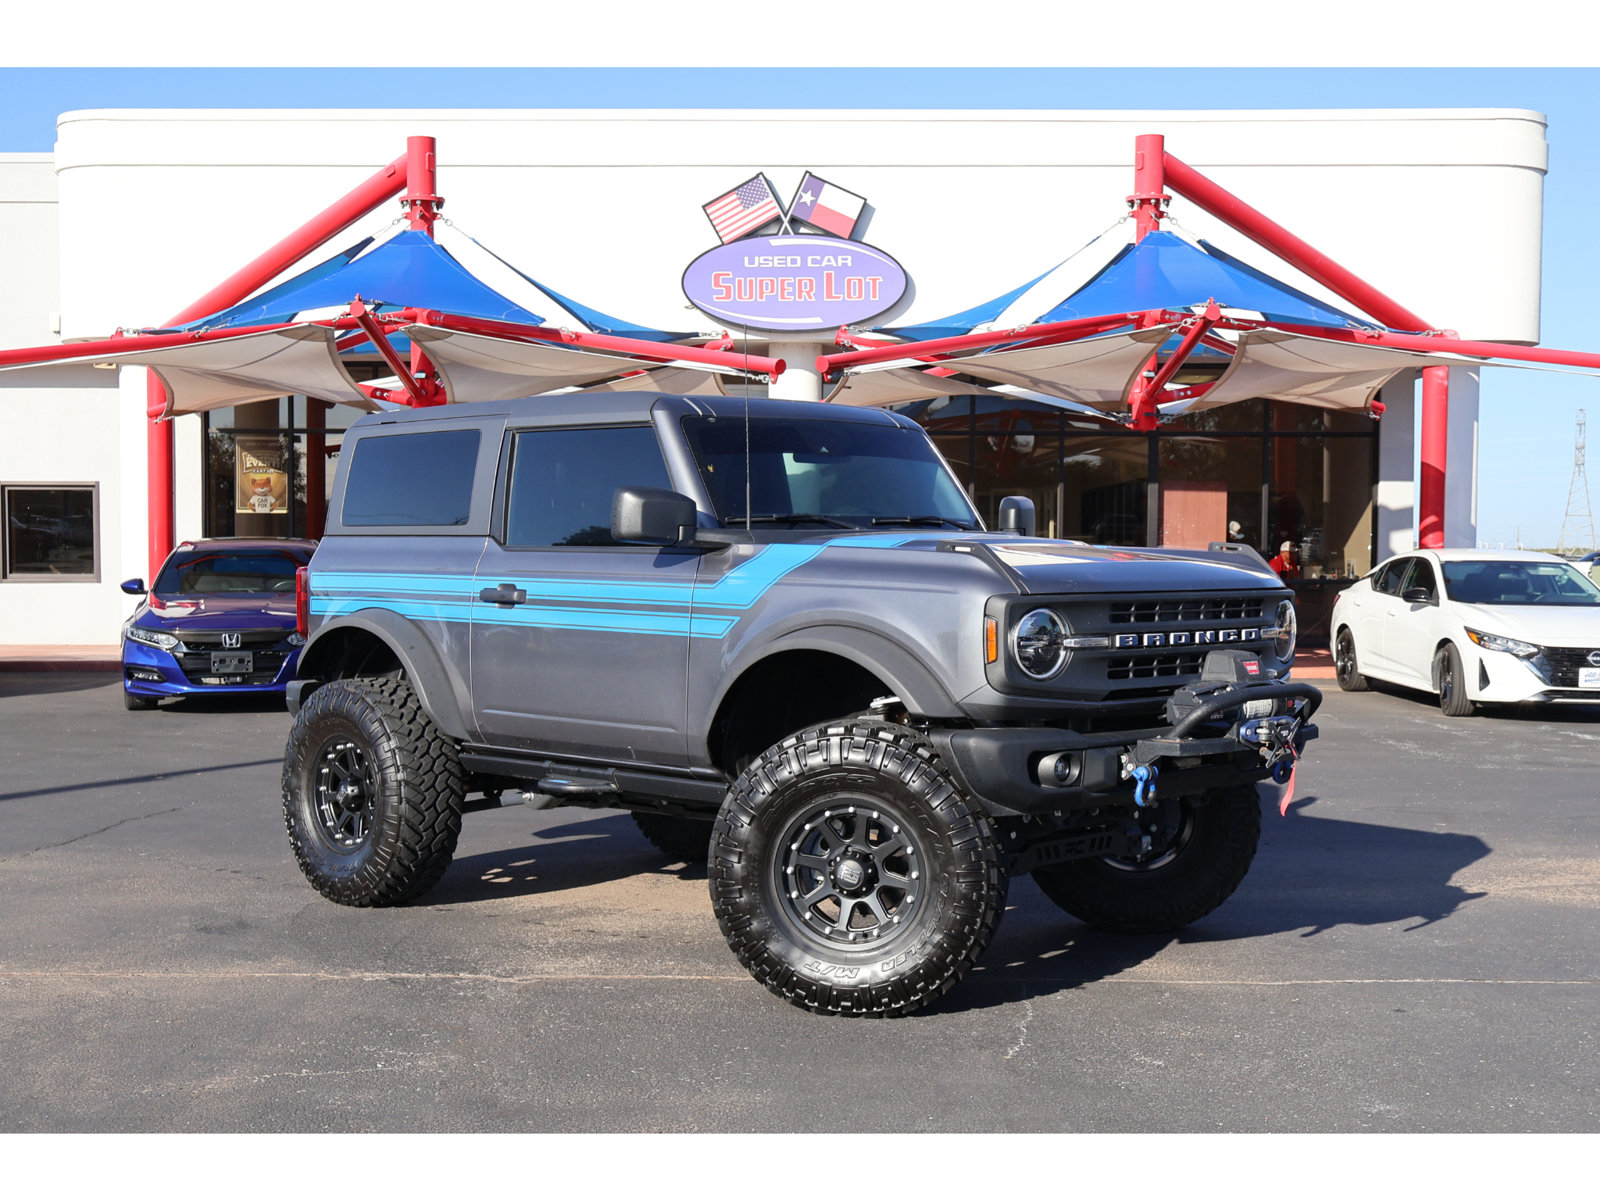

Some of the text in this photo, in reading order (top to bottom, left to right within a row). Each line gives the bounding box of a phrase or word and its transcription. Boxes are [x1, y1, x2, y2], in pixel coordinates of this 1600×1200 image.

[744, 256, 852, 268] USED CAR
[712, 271, 883, 301] SUPER LOT
[1115, 628, 1260, 647] BRONCO
